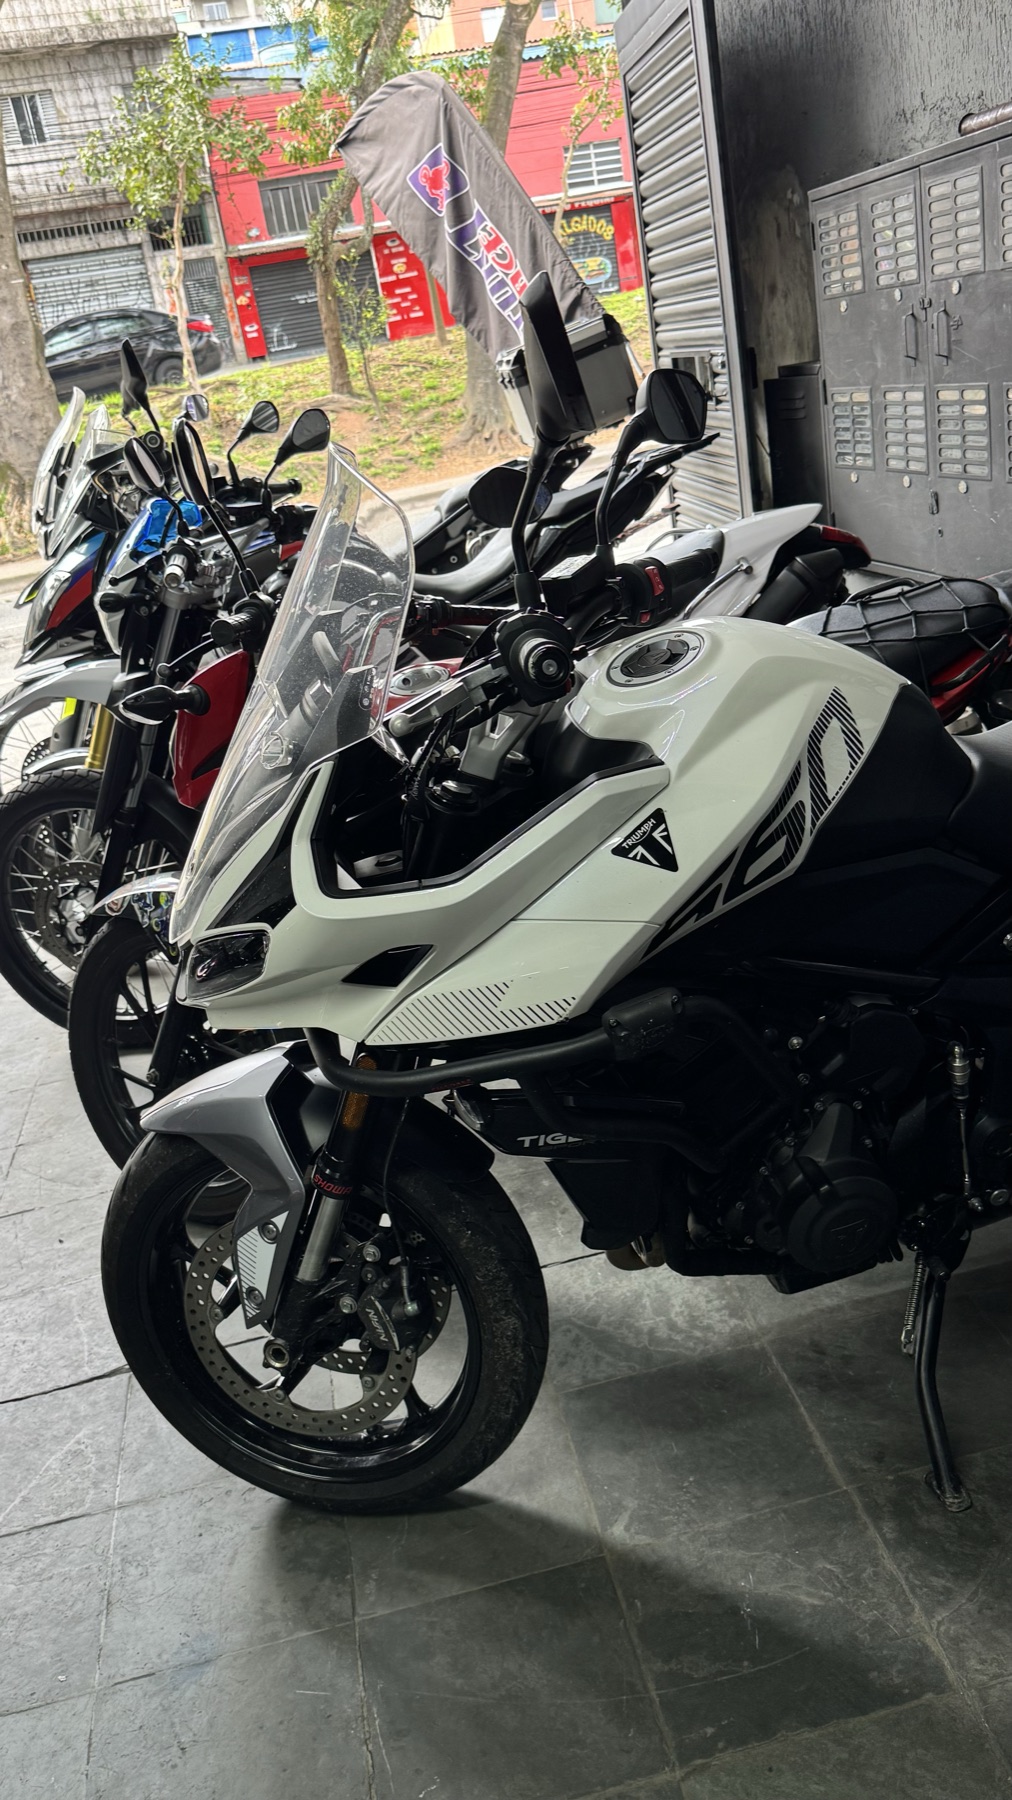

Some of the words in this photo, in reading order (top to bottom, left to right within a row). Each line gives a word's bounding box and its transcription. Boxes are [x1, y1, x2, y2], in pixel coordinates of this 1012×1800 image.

[560, 214, 615, 240] LGADOS
[444, 202, 524, 332] TUNT
[480, 224, 529, 298] ACE
[621, 817, 657, 849] TRIUMPH
[516, 1132, 589, 1149] TIG
